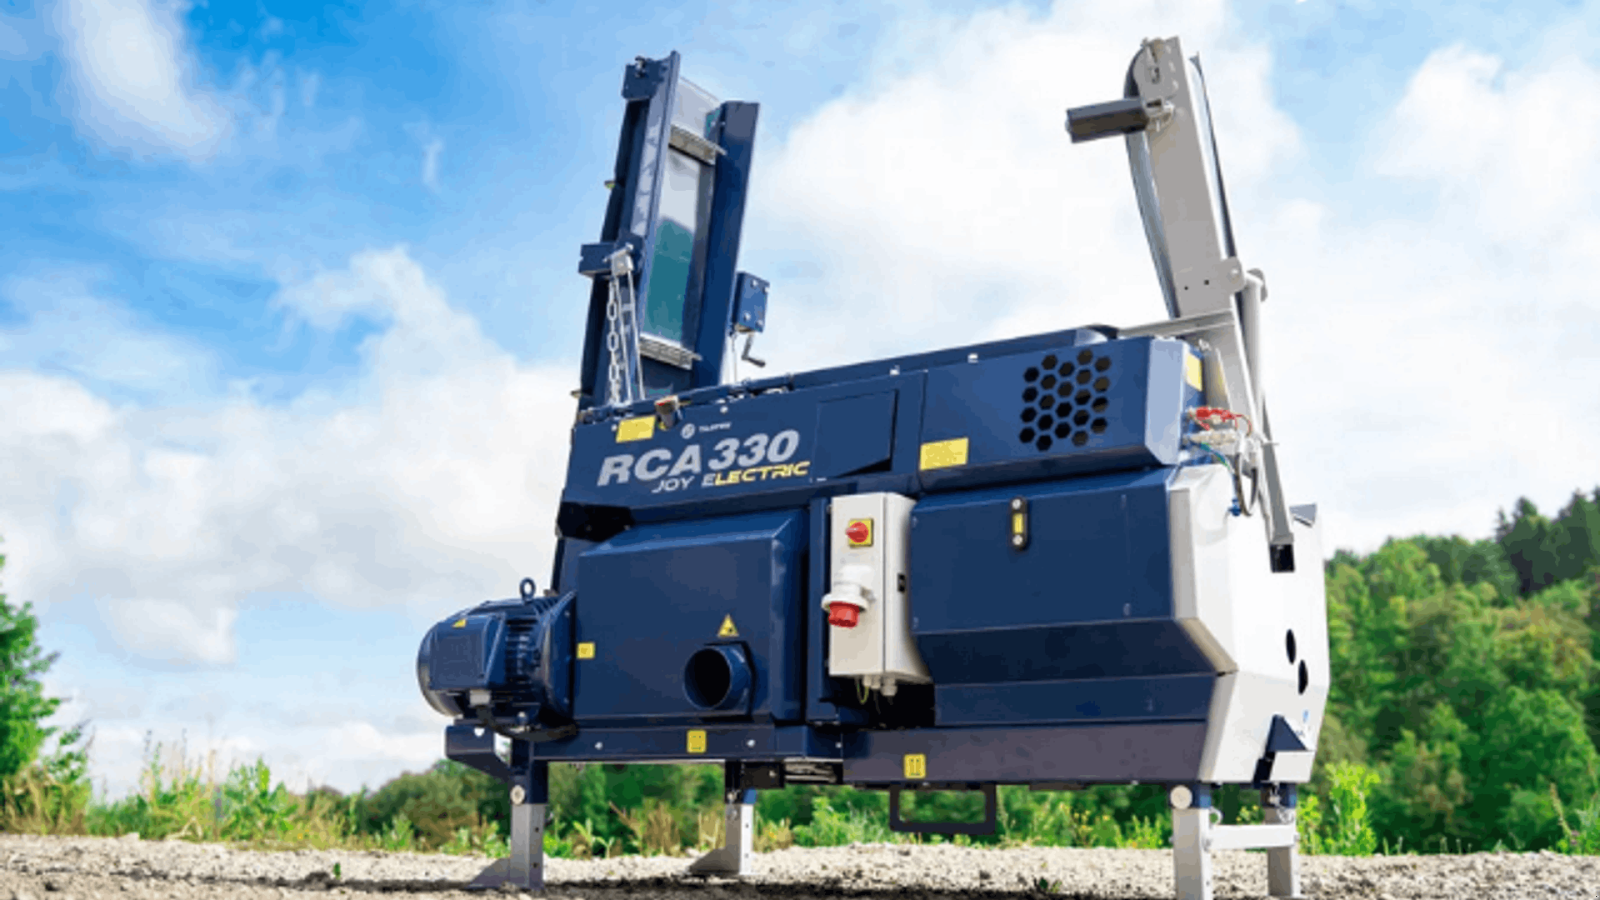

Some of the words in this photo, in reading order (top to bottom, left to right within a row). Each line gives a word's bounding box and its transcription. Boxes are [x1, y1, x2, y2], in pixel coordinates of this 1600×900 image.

[597, 444, 702, 486] RCA
[708, 430, 800, 470] 330
[652, 476, 695, 493] JOY
[701, 461, 811, 487] ELECTRIC
